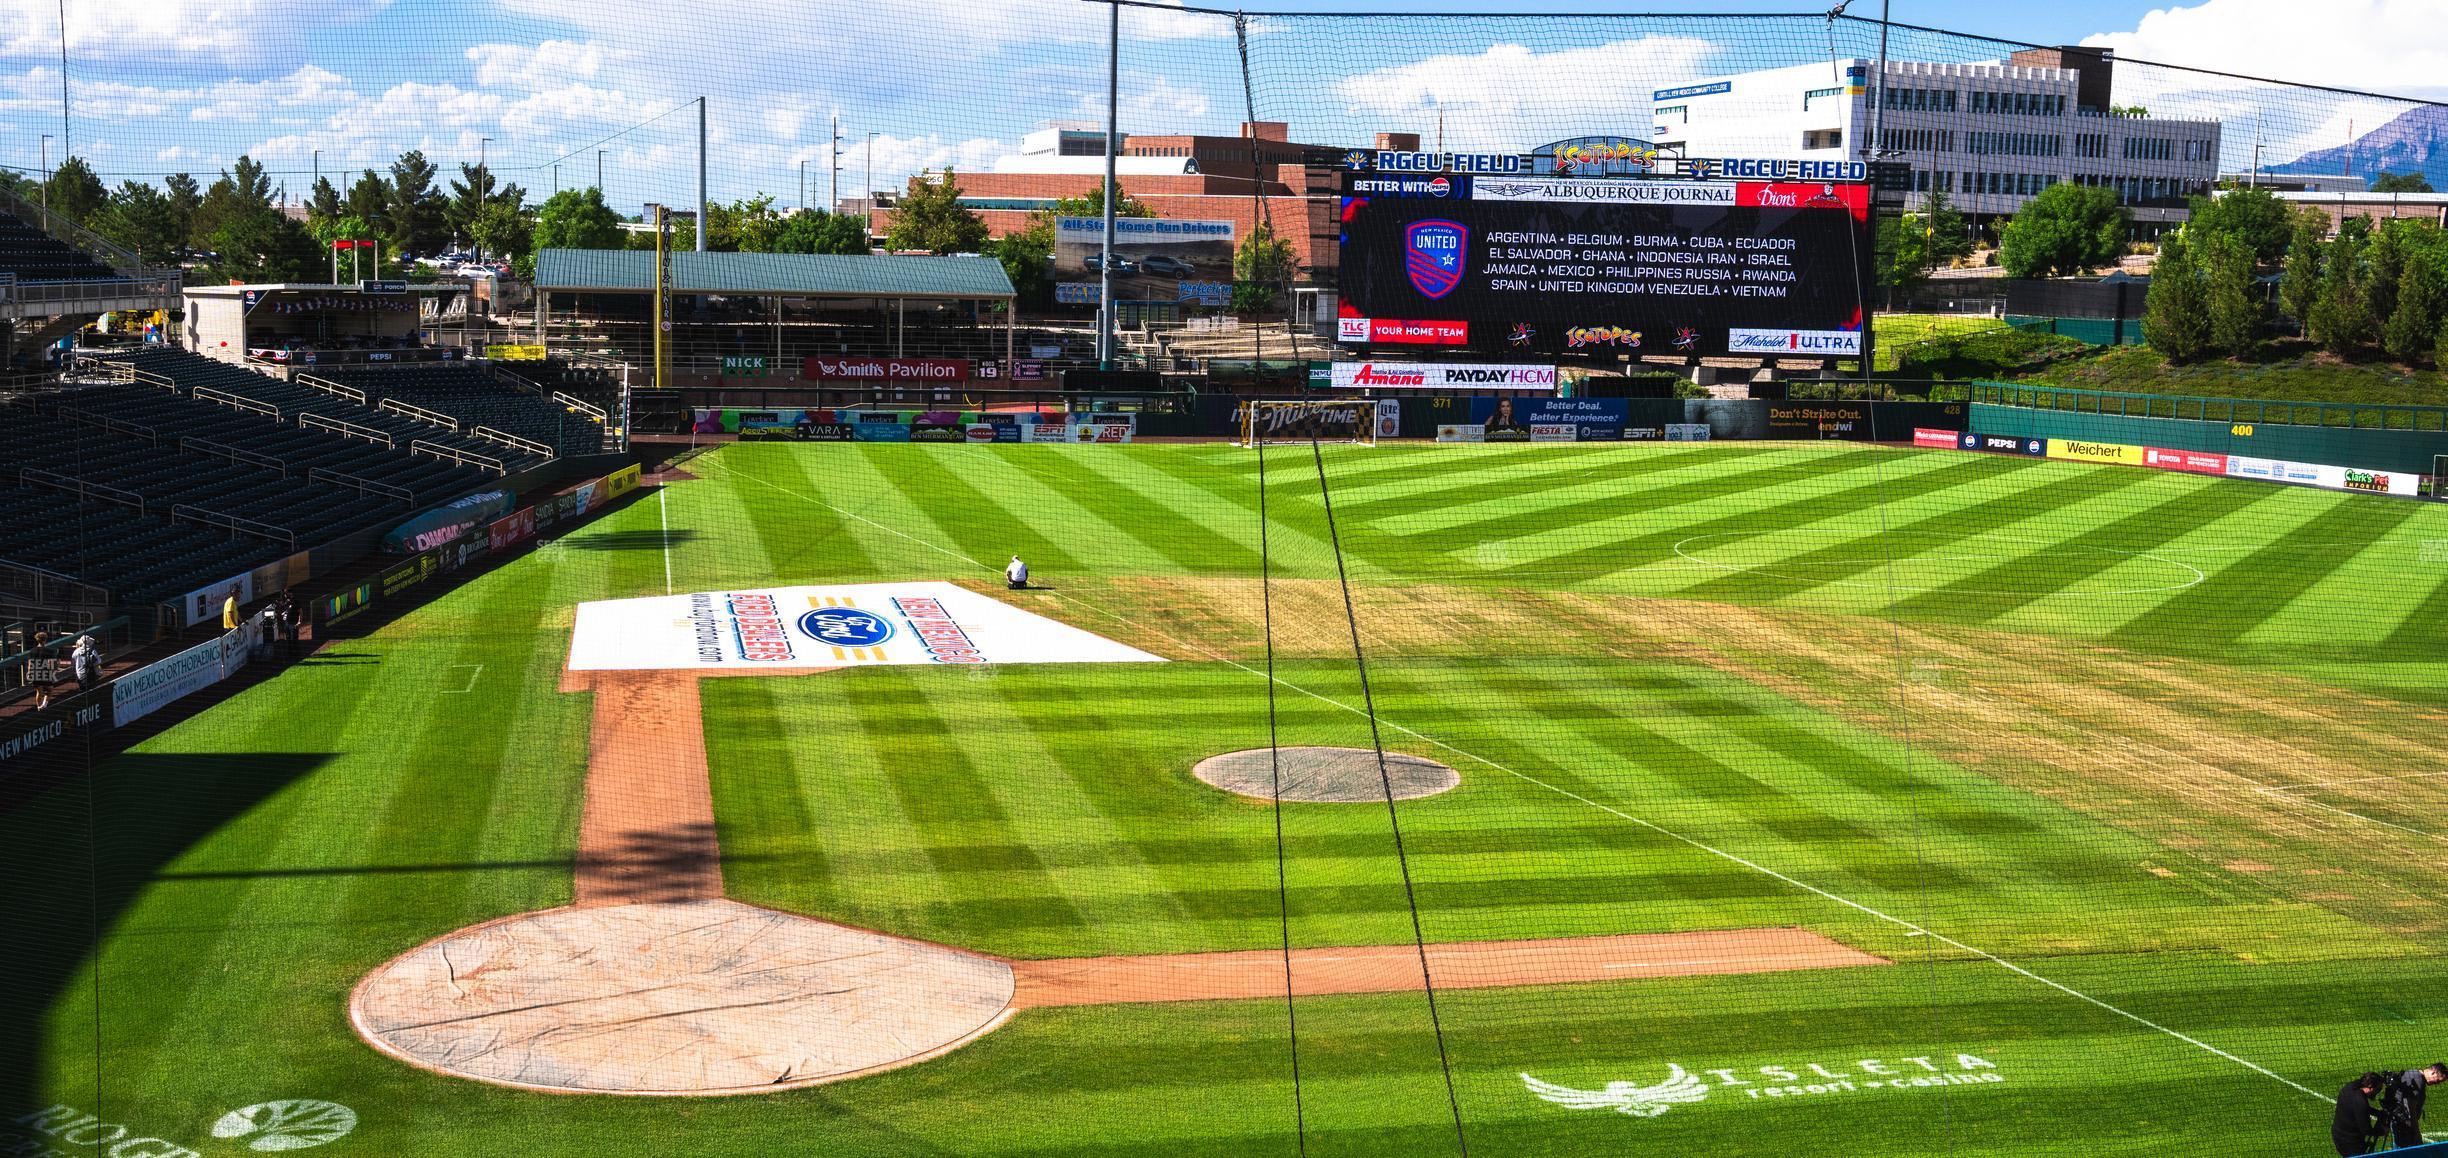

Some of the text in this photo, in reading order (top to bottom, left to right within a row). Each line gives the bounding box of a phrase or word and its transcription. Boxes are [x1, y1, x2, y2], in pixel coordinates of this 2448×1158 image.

[1377, 150, 1519, 174] RGCU FIELD
[1721, 158, 1867, 181] RGCU FIELD
[1354, 180, 1432, 192] BETTER WITH
[1543, 185, 1734, 202] ALBUQUERQUE JOURNAL
[1757, 184, 1797, 206] Dion's
[1063, 219, 1231, 235] All-Sta Home Run Drivers
[1417, 235, 1457, 249] UNITED
[1486, 232, 1796, 250] ARGENTINA BELGIUM BURMA CUBA ECUADOR
[1489, 247, 1791, 266] EL SALVADOR GHANA INDONESIA IRAN ISRAEL
[1482, 263, 1796, 282] JAMAICA MEXICO PHILIPPINES RUSSIA RWANDA
[1178, 280, 1233, 302] Perfection
[1491, 280, 1786, 297] SPAIN UNITED KINGDOM VENEZUELA VIETNAM
[1343, 322, 1364, 331] TLC
[1375, 326, 1464, 337] YOUR HOME TEAM
[1733, 334, 1855, 349] Michelob ULTRA
[369, 353, 392, 361] PEPSI
[726, 358, 762, 368] NICK
[838, 361, 956, 377] Smith's Pavilion
[979, 367, 997, 378] 19
[1353, 364, 1424, 385] Amana
[1379, 403, 1398, 416] Lite
[1432, 397, 1451, 408] 371
[1546, 401, 1602, 411] Better Deal.
[1944, 405, 1961, 415] 428
[1319, 409, 1357, 423] TIME
[1530, 412, 1561, 422] Better
[1769, 408, 1862, 419] Don't Strike Out.
[808, 425, 841, 435] VARA
[1102, 426, 1127, 438] RED
[1818, 421, 1852, 431] endwi
[2231, 425, 2253, 436] 400
[1988, 438, 2016, 449] PEPSI
[2067, 442, 2122, 458] Weichert
[2159, 455, 2180, 463] TOYOTA
[2345, 469, 2389, 485] Clark's Pet
[2345, 481, 2388, 492] EMPORIUM
[889, 596, 952, 620] NEW
[726, 594, 796, 662] FORD DEALERS
[814, 613, 879, 640] Ford
[905, 617, 987, 664] MEXICO
[115, 646, 221, 704] NEW MEXICO ORTHOPAEDICS
[24, 719, 62, 751] MEXICO
[75, 703, 100, 727] TRUE
[1706, 1053, 1999, 1086] ISLETA
[1745, 1072, 2004, 1101] resort casino
